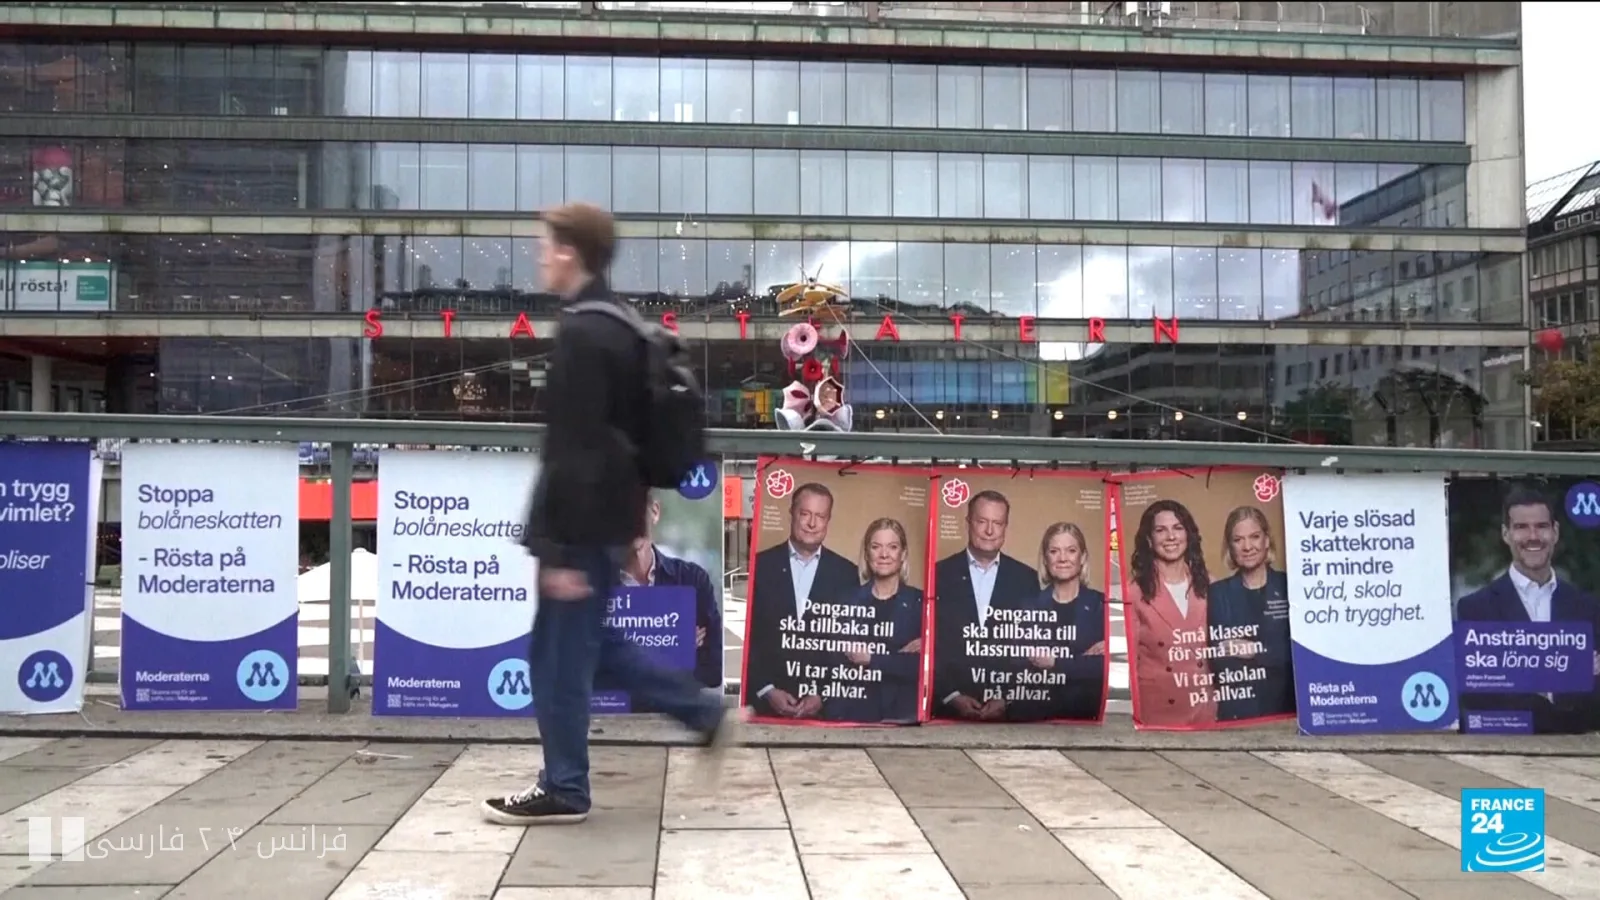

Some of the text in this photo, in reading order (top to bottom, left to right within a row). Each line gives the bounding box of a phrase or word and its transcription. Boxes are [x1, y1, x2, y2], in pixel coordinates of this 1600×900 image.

[20, 278, 68, 292] rösta!
[12, 479, 70, 502] trygg
[137, 484, 214, 508] Stoppa
[393, 490, 470, 515] Stoppa
[138, 510, 282, 530] bolåneskatten
[1299, 509, 1415, 532] Varje slösad
[1300, 534, 1415, 553] skattekrona
[154, 547, 213, 567] Rösta
[220, 547, 246, 571] på
[408, 555, 468, 575] Rösta
[474, 555, 500, 580] på
[1302, 557, 1394, 576] är mindre
[138, 575, 275, 594] Moderaterna
[391, 582, 528, 602] Moderaterna
[1303, 580, 1402, 602] vård, skola
[626, 594, 631, 609] i
[803, 599, 876, 620] Pengarna
[983, 605, 1057, 626] Pengarna
[1304, 605, 1339, 624] och
[1345, 603, 1425, 627] trygghet.
[779, 618, 894, 638] ska tillbaka till
[962, 623, 1077, 641] ska tillbaka till
[1172, 623, 1259, 645] Små klasser
[781, 633, 890, 655] klassrummen.
[965, 640, 1074, 658] klassrummen.
[1464, 628, 1587, 650] Ansträngning
[1168, 638, 1268, 662] för små barn.
[786, 661, 882, 681] Vi tar skolan
[1465, 650, 1569, 672] ska löna sig
[136, 671, 210, 682] Moderaterna
[387, 677, 461, 689] Moderaterna
[971, 667, 1066, 685] Vi tar skolan
[1173, 666, 1267, 688] Vi tar skolan
[799, 681, 868, 699] på allvar.
[983, 685, 1051, 701] på allvar.
[1189, 684, 1256, 707] på allvar.
[1309, 680, 1355, 696] Rösta på
[1310, 694, 1378, 706] Moderaterna
